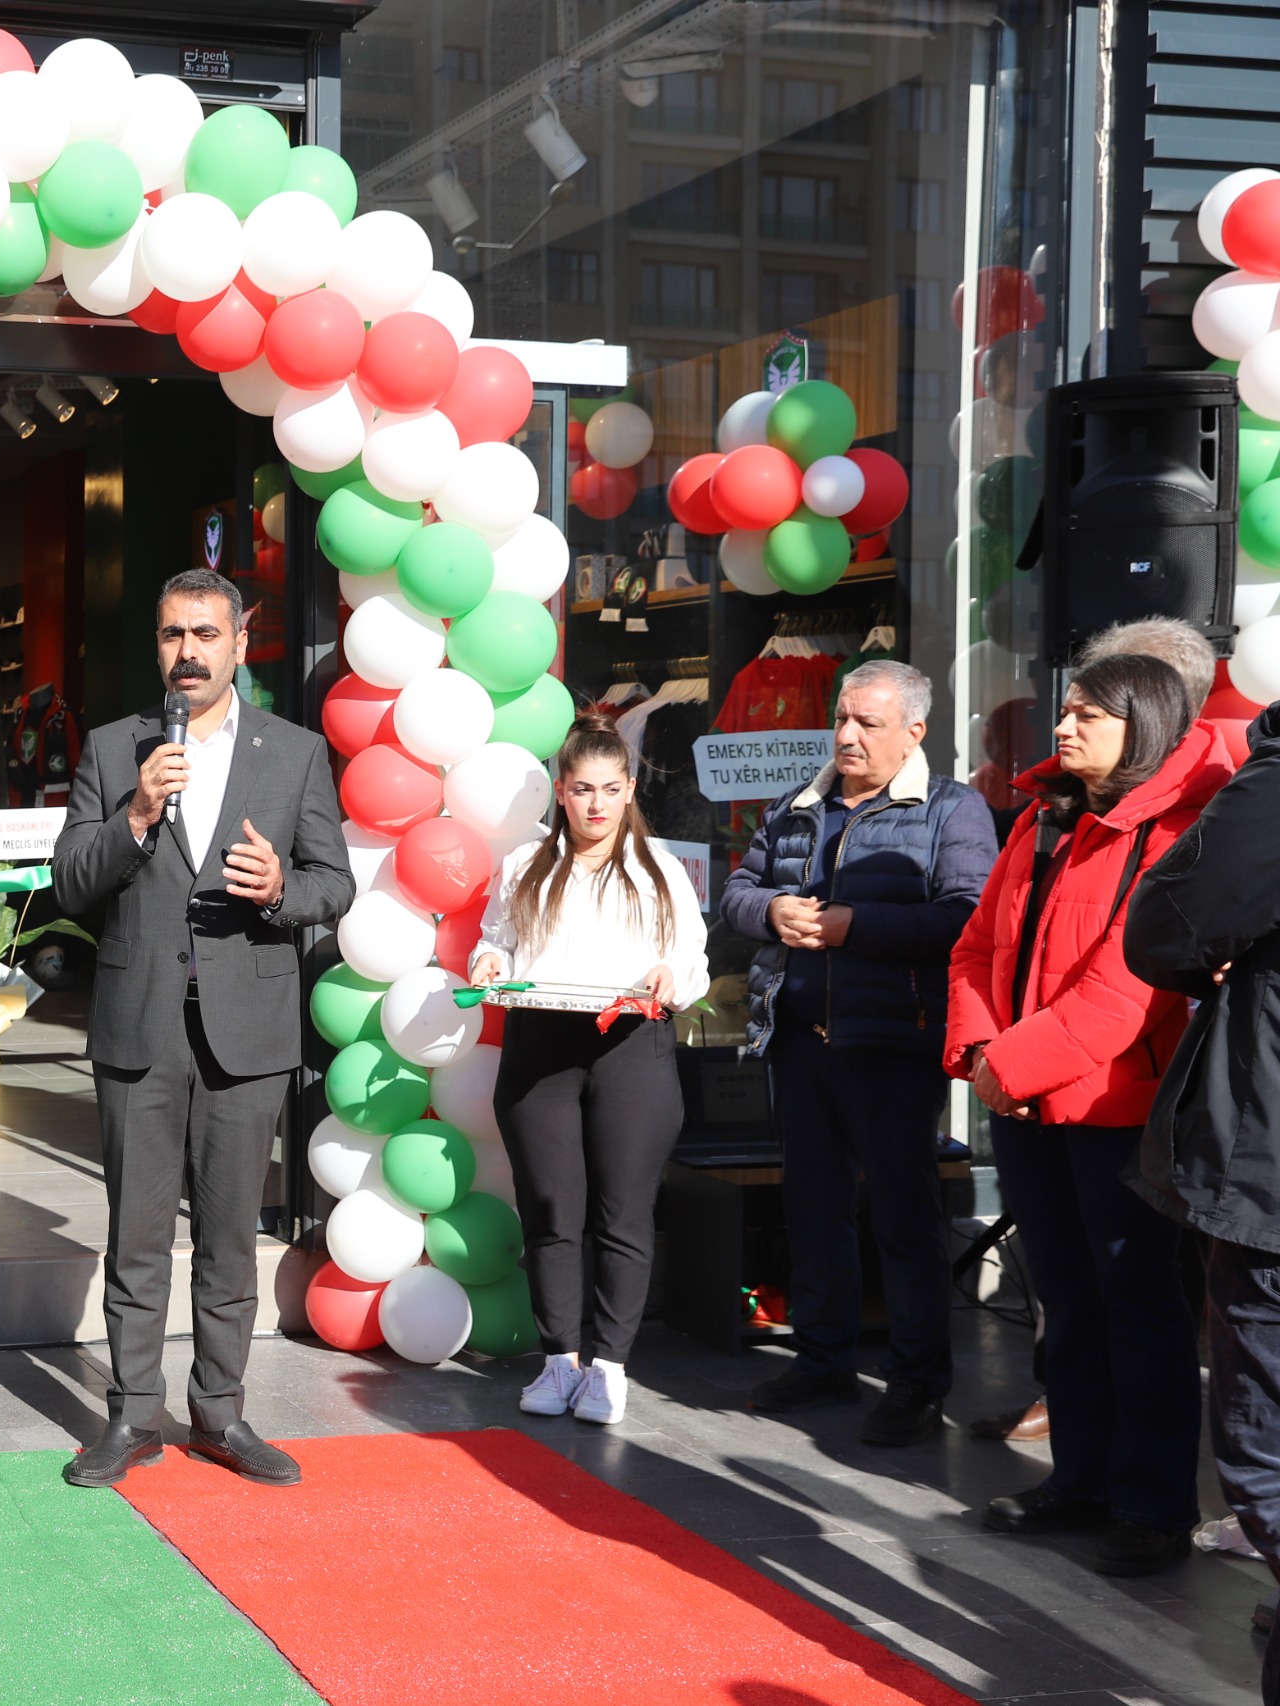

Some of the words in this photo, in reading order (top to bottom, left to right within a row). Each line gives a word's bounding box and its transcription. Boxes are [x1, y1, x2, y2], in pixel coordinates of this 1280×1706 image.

[196, 64, 208, 72] 235
[1130, 562, 1151, 573] RCF
[707, 743, 763, 759] EMEK75
[766, 738, 828, 757] KİTABEVİ
[710, 769, 730, 784] TU
[733, 764, 762, 784] XÊR
[765, 762, 797, 783] HATÎ
[3, 838, 31, 850] MECLİS
